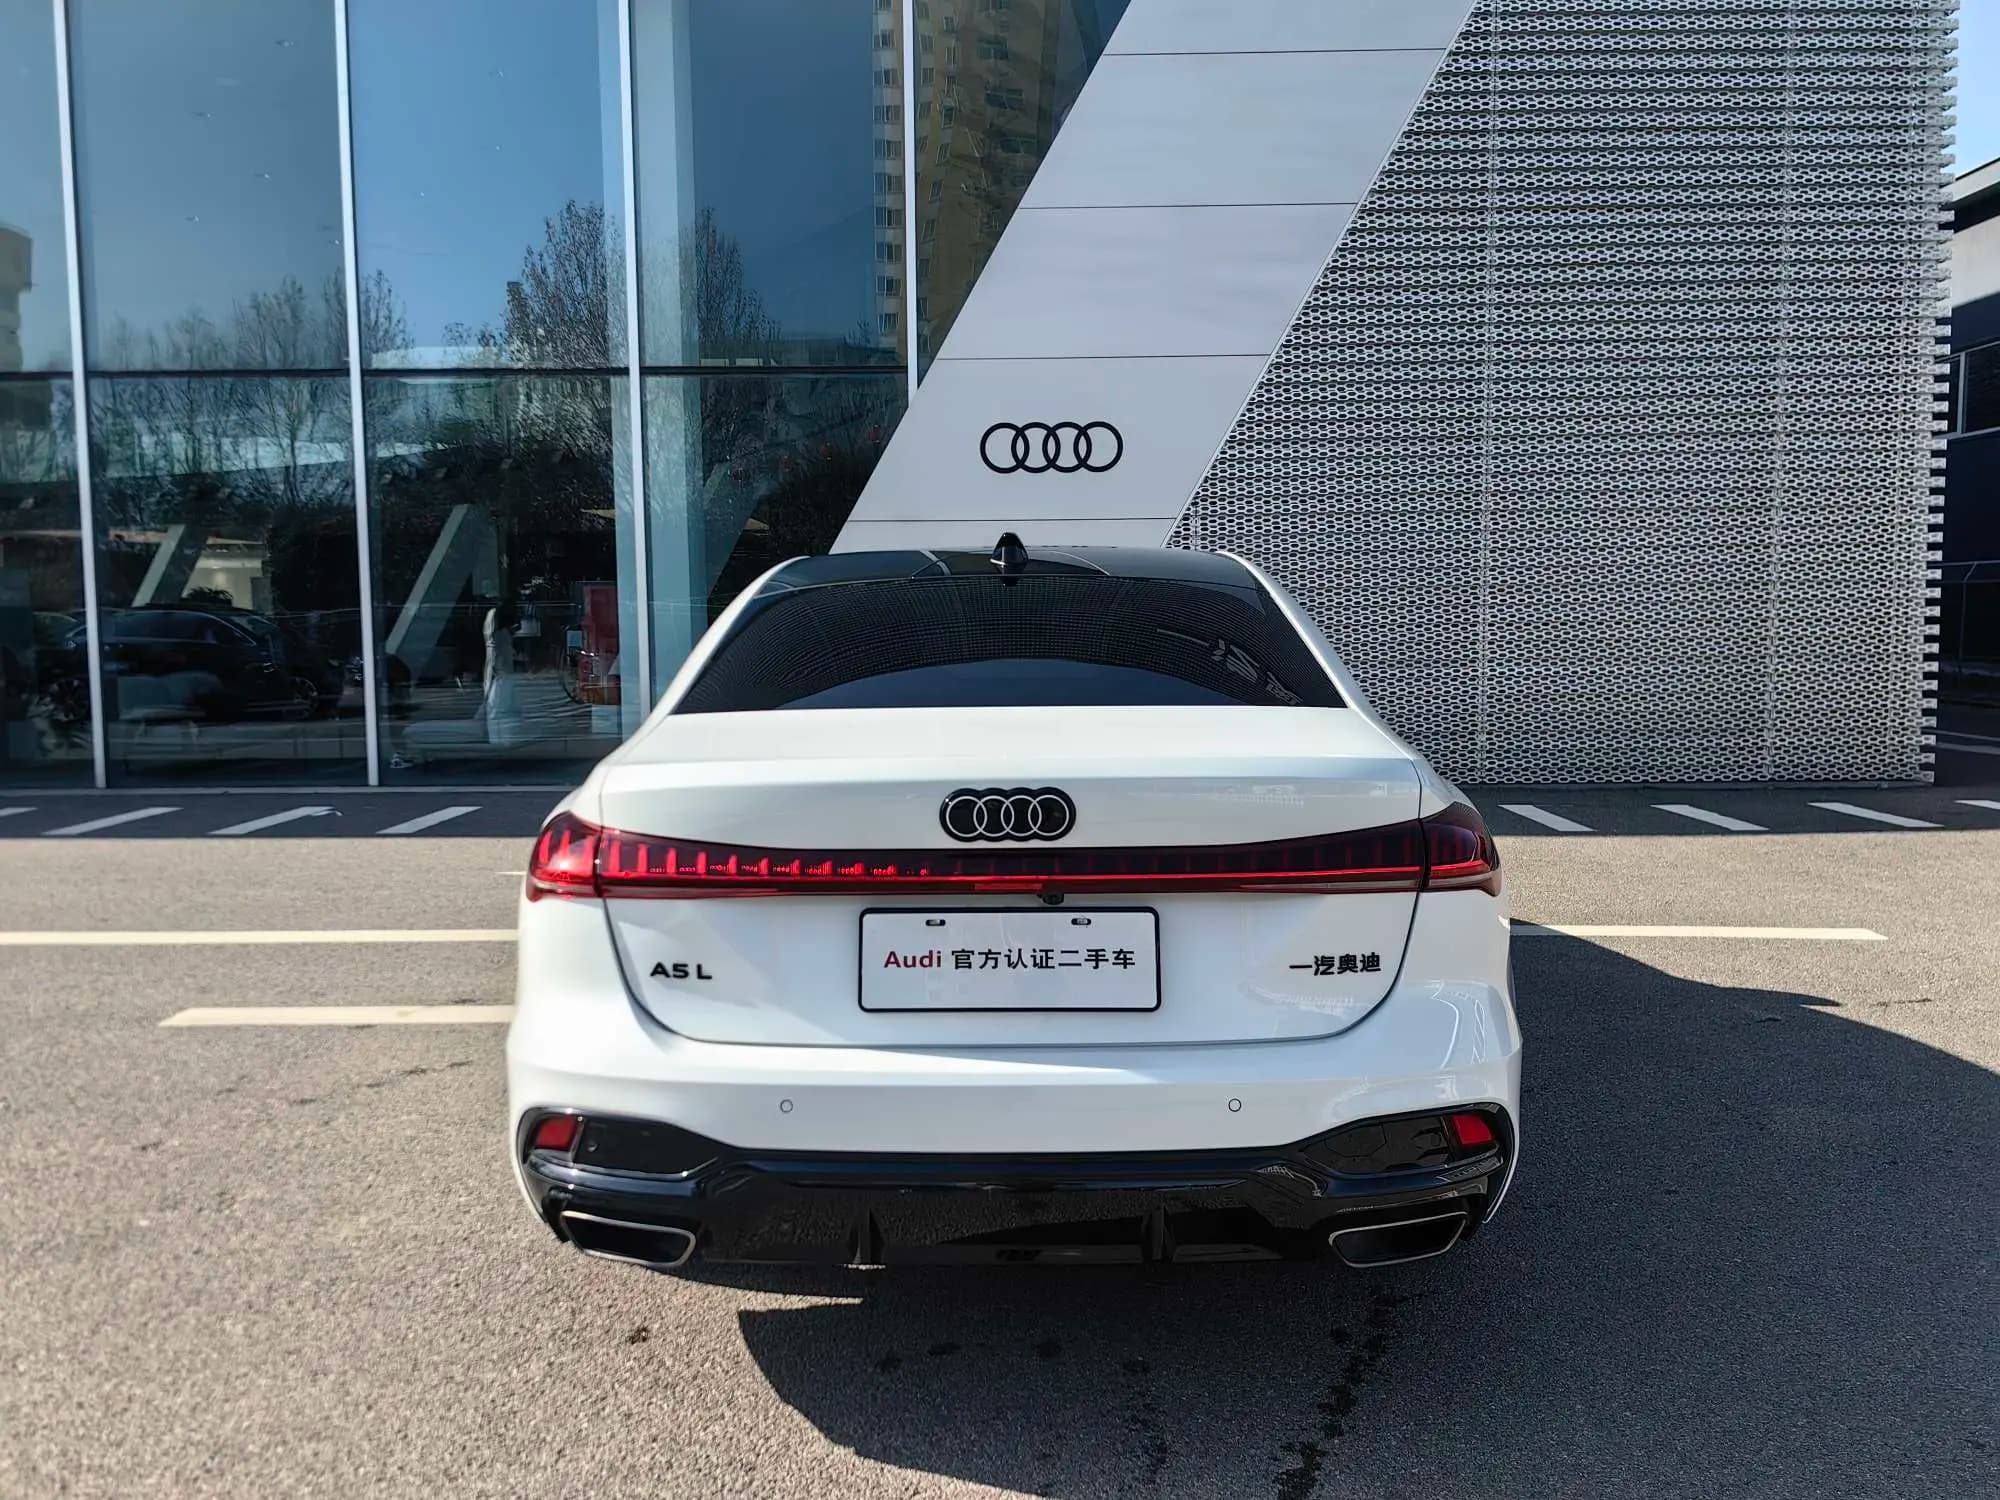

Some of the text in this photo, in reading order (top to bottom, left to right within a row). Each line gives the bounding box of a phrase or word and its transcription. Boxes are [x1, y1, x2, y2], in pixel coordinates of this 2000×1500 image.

[883, 947, 1136, 970] Audi 官方认证二手车
[1288, 951, 1382, 977] 一汽奥迪
